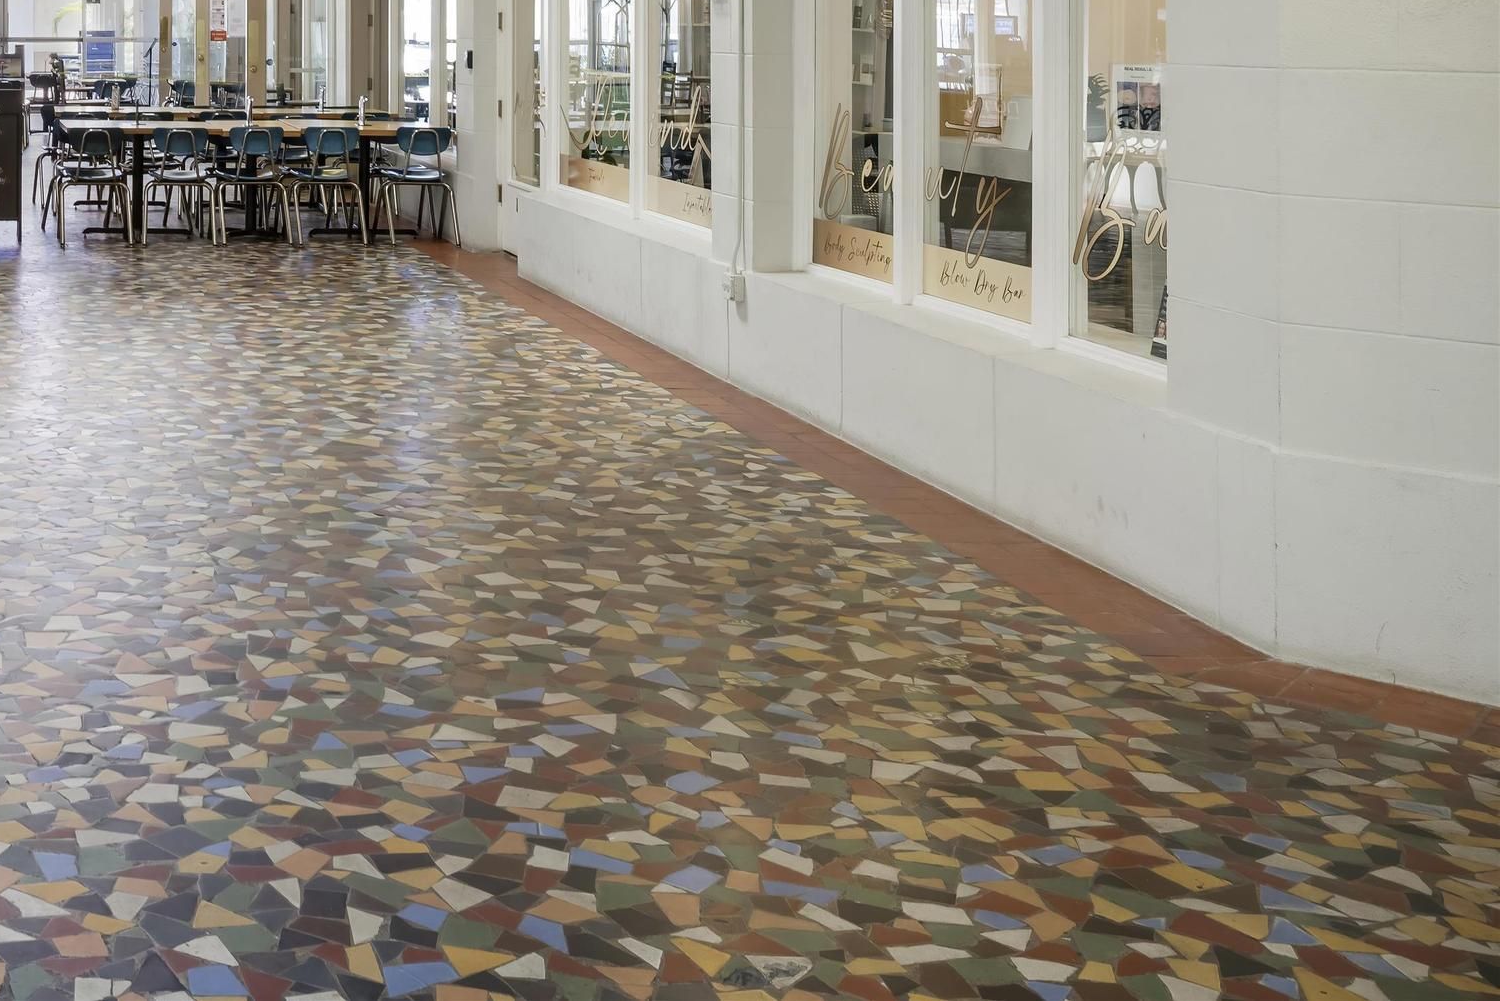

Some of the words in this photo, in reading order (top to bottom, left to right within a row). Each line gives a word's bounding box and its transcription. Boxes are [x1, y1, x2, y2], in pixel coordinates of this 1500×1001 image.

[824, 233, 846, 262] Body
[848, 239, 893, 273] Sculpting
[940, 260, 969, 286] Blow
[974, 269, 999, 303] Dry
[1002, 276, 1025, 304] Bar
